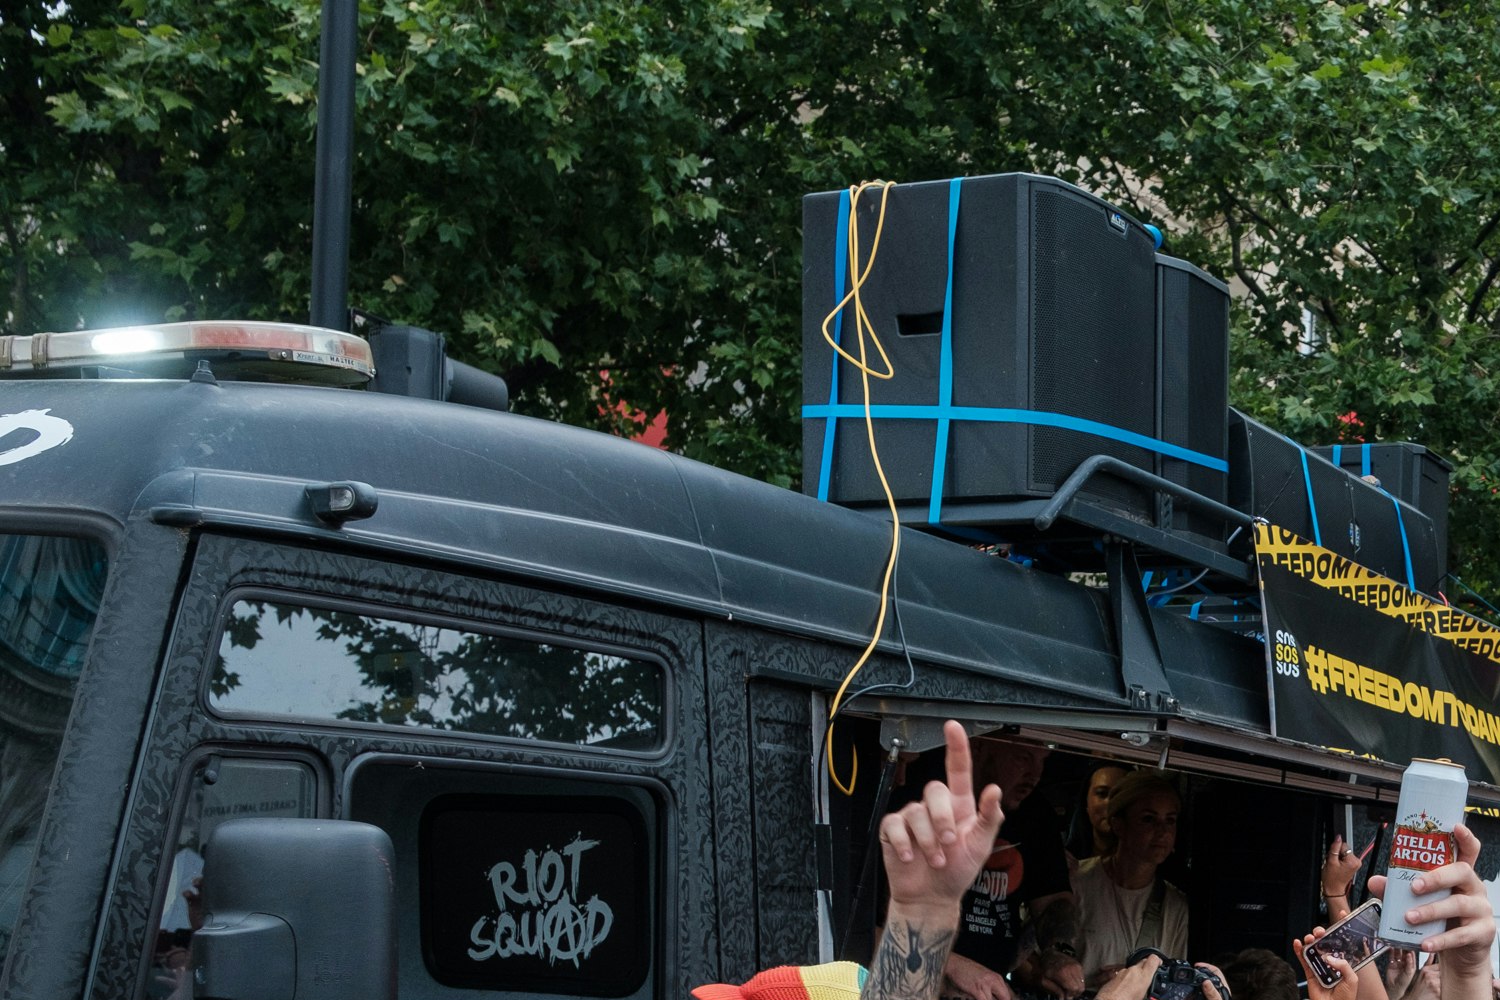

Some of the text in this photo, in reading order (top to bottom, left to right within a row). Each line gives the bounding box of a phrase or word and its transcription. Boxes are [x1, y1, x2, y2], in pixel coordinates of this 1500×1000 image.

[1276, 643, 1299, 665] SOS
[1396, 834, 1446, 853] STELLA
[1393, 848, 1445, 866] ARTOIS
[484, 831, 601, 911] RIOT
[467, 889, 614, 969] SQUAD
